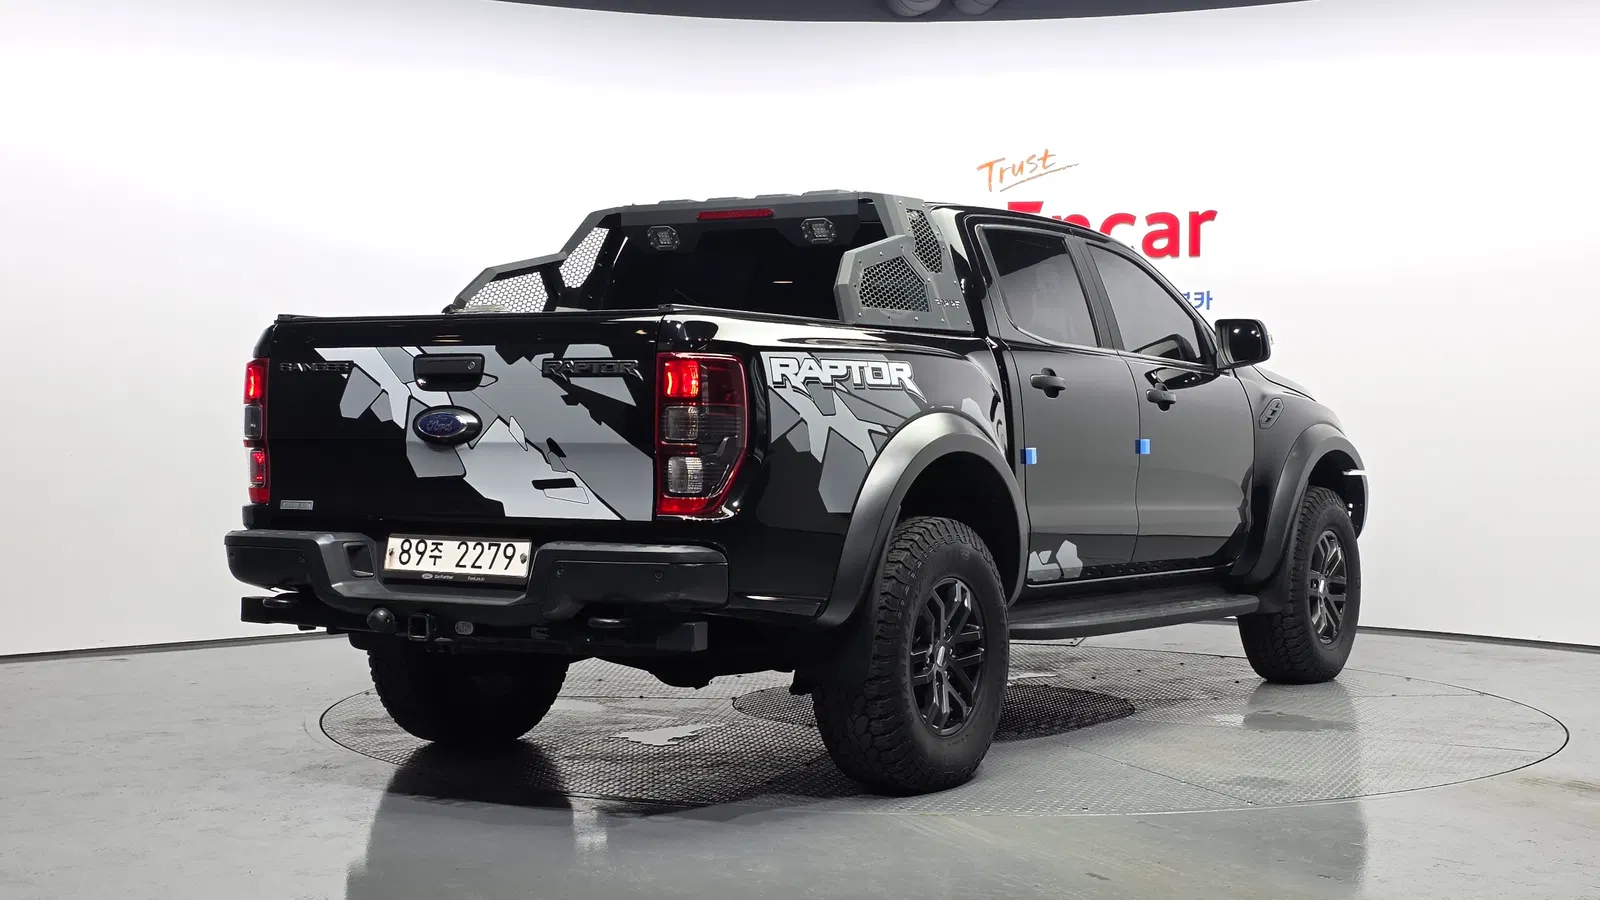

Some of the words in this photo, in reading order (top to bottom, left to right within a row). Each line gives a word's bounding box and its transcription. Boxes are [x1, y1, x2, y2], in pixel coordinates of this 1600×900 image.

[976, 148, 1056, 192] Trust
[280, 362, 349, 372] RANGER
[543, 359, 644, 381] RAPTOR
[769, 357, 927, 403] RAPTOR
[426, 419, 454, 432] Ford
[399, 538, 443, 566] 89주
[455, 541, 516, 571] 2279
